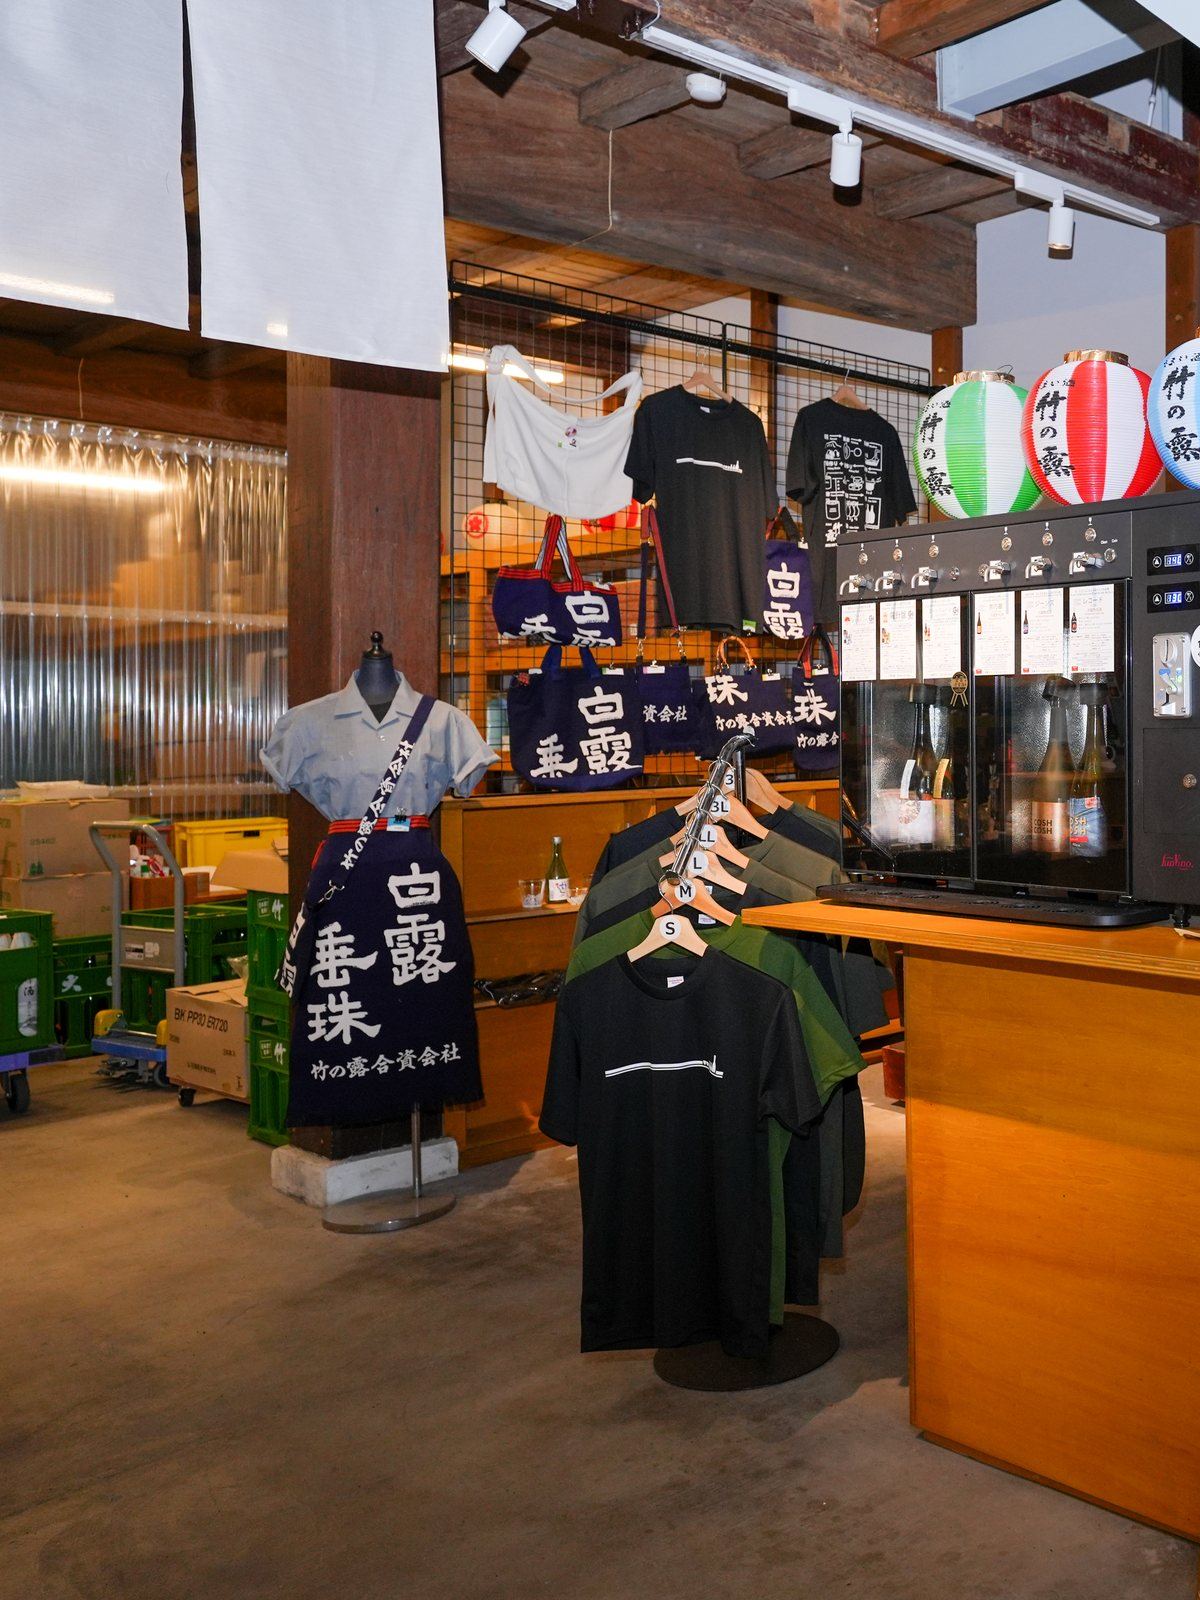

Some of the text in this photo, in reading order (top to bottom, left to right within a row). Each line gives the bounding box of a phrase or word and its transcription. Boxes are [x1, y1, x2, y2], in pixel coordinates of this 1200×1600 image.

[1035, 390, 1076, 477] 竹の露
[919, 412, 954, 496] 竹の露
[704, 675, 749, 706] 珠
[793, 687, 837, 726] 珠
[643, 704, 688, 723] 資会社
[711, 801, 729, 814] 3L
[692, 857, 702, 870] L
[679, 885, 692, 898] M
[384, 862, 457, 986] 白露
[664, 922, 676, 935] S
[307, 921, 382, 1044] 垂珠
[310, 1042, 462, 1081] 竹の露合資会社
